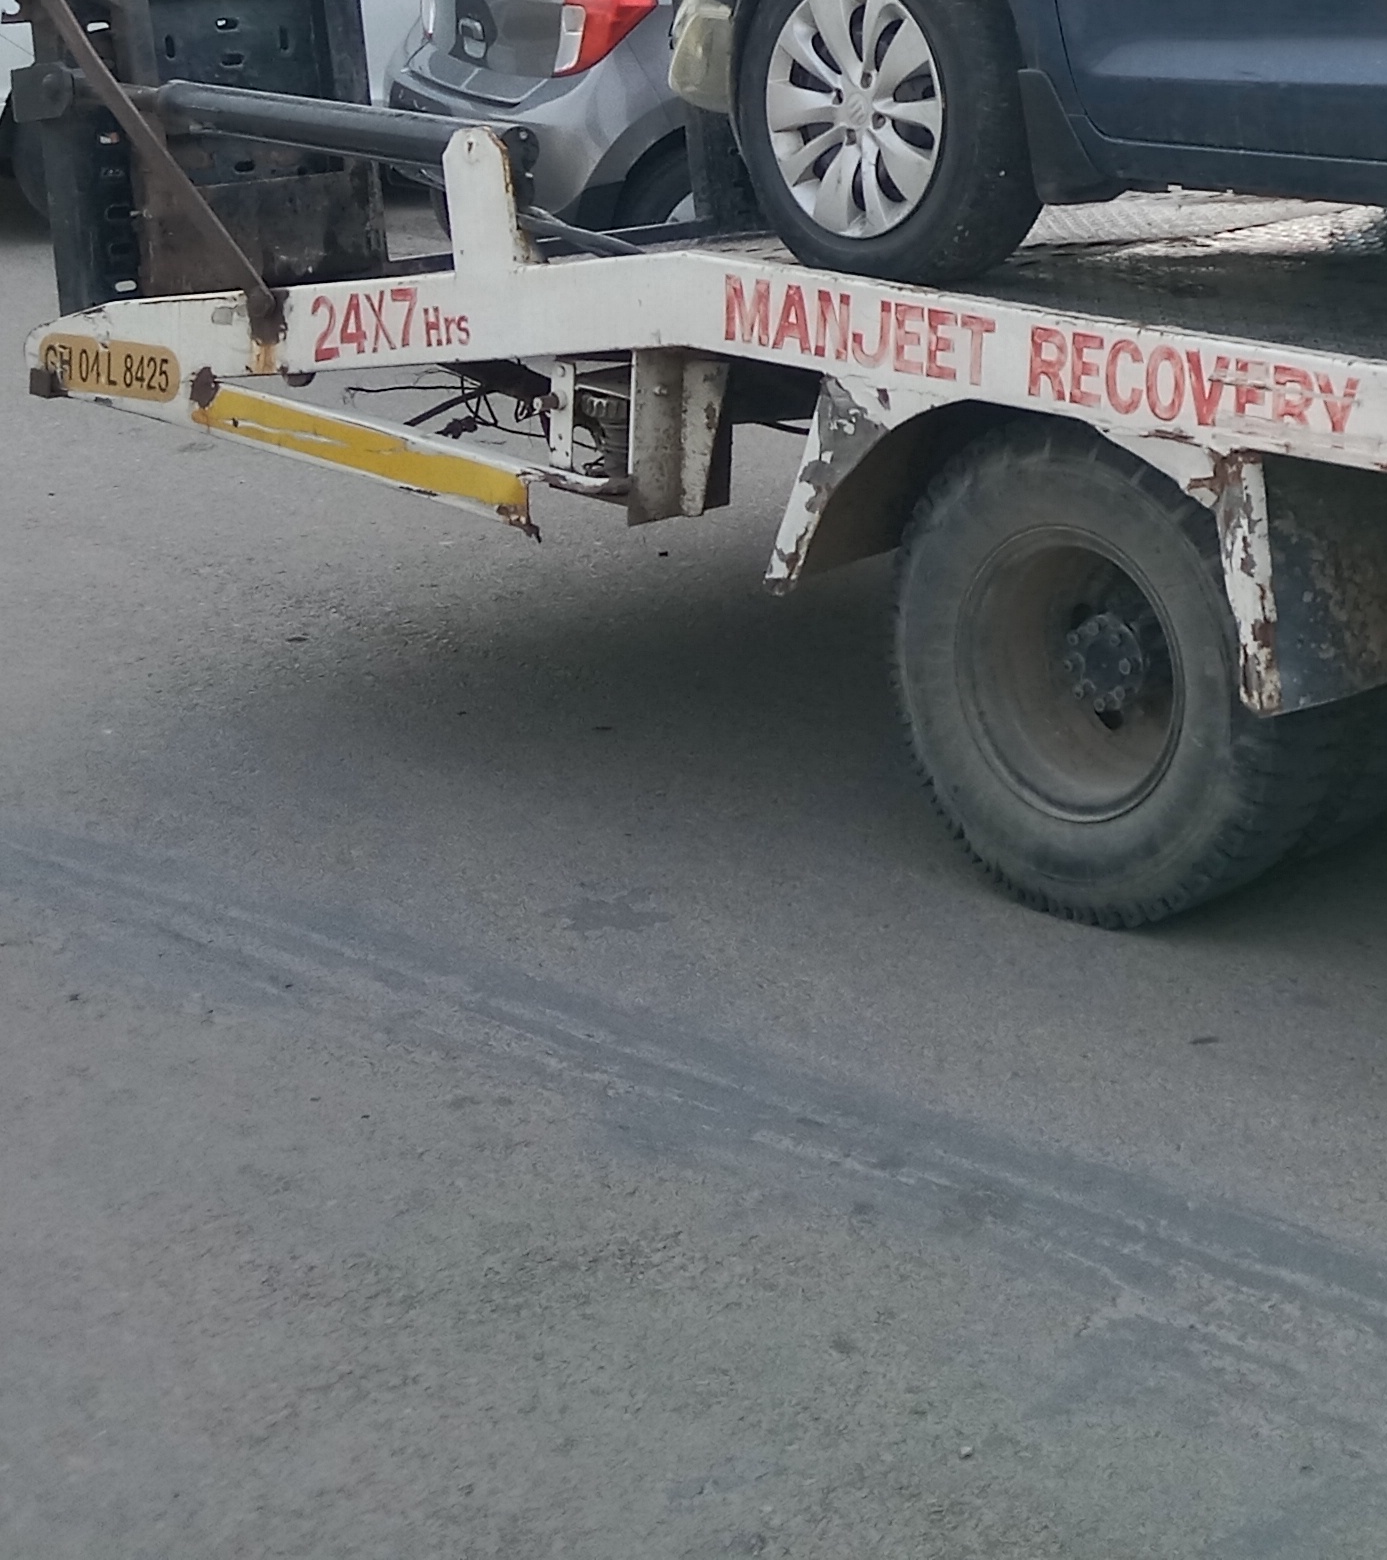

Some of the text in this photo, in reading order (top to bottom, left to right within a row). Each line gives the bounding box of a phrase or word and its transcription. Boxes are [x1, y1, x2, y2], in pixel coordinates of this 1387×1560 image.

[311, 287, 470, 362] 24X7 Hrs
[725, 274, 996, 386] MANJEET
[1027, 324, 1361, 438] RECOVERY
[123, 353, 169, 393] 8425
